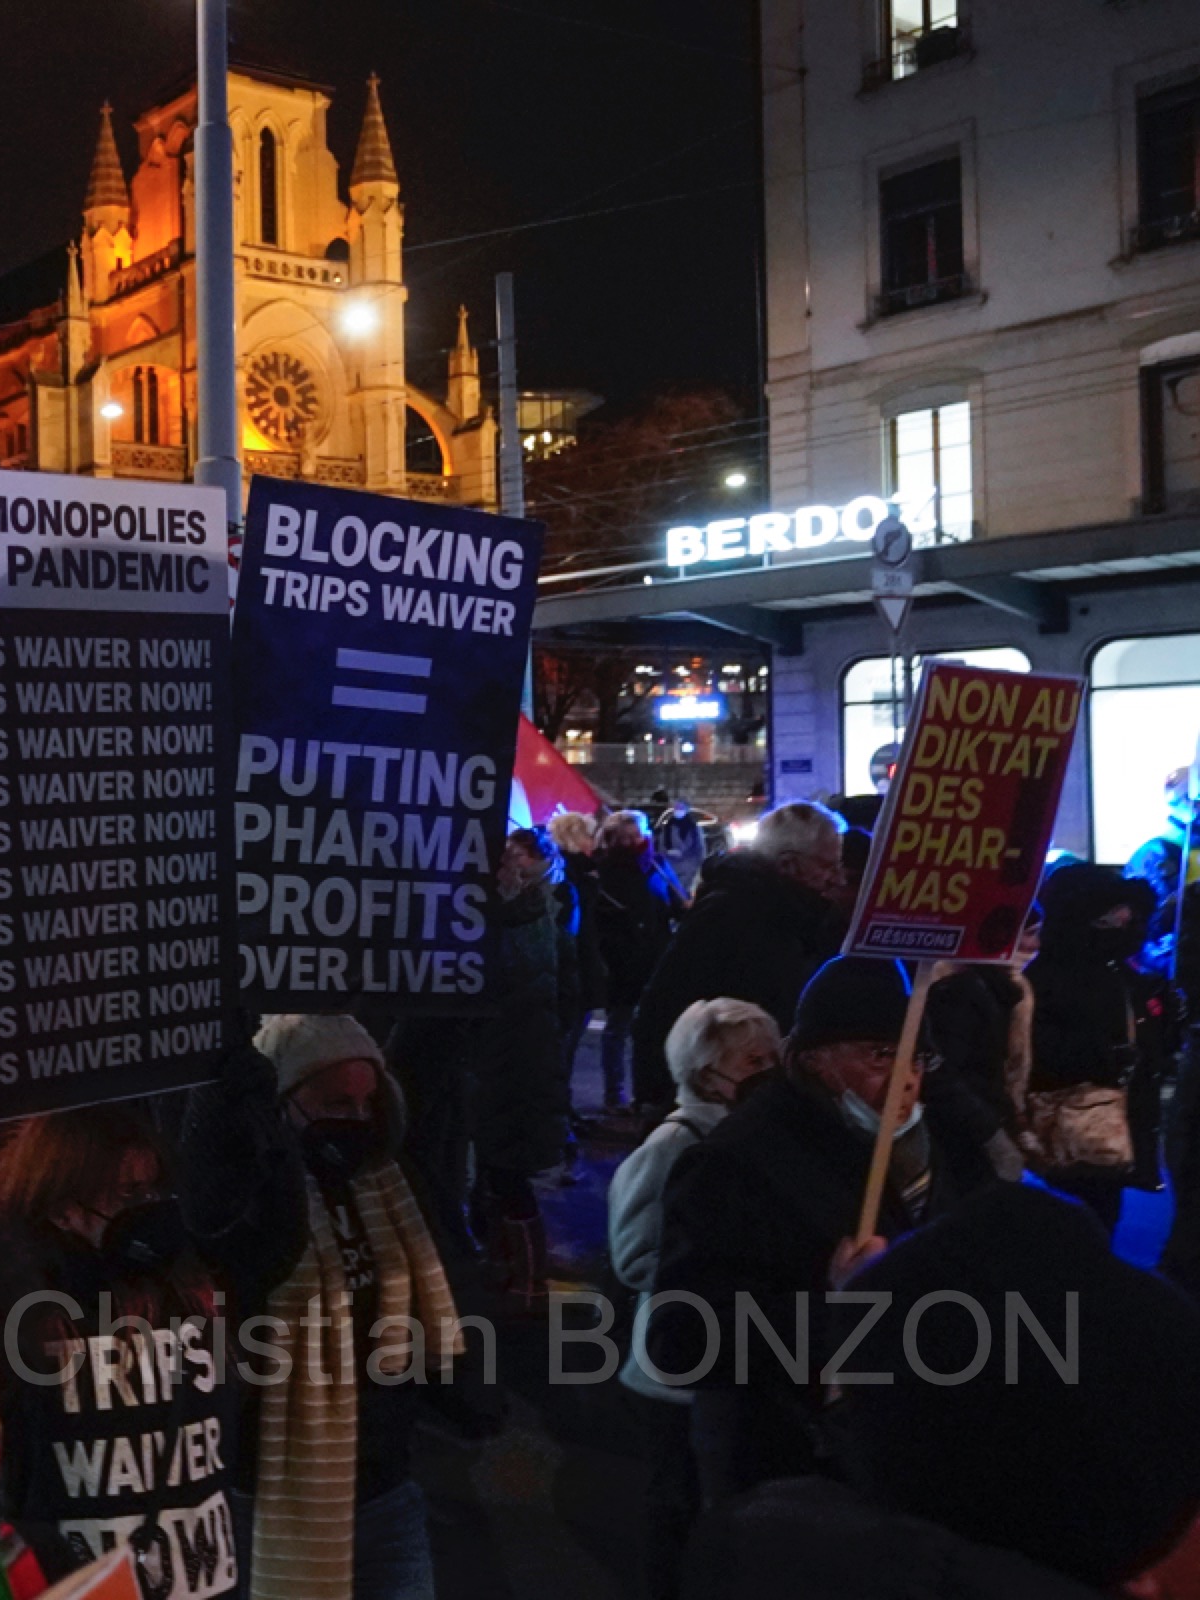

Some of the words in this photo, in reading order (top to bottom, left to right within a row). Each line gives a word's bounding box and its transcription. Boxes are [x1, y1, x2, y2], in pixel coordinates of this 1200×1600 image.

[8, 545, 210, 593] PANDEMIC
[264, 503, 524, 591] BLOCKING
[260, 567, 370, 617] TRIPS
[382, 583, 516, 637] WAIVER
[14, 636, 130, 669] WAIVER
[140, 639, 212, 668] NOW!
[16, 682, 132, 714] WAIVER
[141, 682, 213, 712] NOW!
[925, 675, 1022, 729] NON
[1023, 688, 1080, 734] AU
[17, 727, 133, 760] WAIVER
[142, 724, 214, 753] NOW!
[913, 725, 1059, 779] DIKTAT
[19, 771, 135, 805] WAIVER
[144, 767, 215, 798] NOW!
[236, 733, 496, 811] PUTTING
[901, 773, 984, 821] DES
[20, 814, 136, 850] WAIVER
[144, 810, 216, 842] NOW!
[234, 802, 490, 874] PHARMA
[890, 821, 1021, 869] PHAR-
[21, 858, 137, 896] WAIVER
[145, 852, 217, 885] NOW!
[875, 867, 971, 914] MAS
[23, 902, 138, 943] WAIVER
[147, 894, 218, 929] NOW!
[24, 946, 139, 989] WAIVER
[148, 936, 220, 972] NOW!
[363, 948, 485, 994] LIVES
[26, 990, 141, 1034] WAIVER
[150, 978, 221, 1016] NOW!
[28, 1033, 142, 1080] WAIVER
[151, 1020, 222, 1059] NOW!
[44, 1322, 216, 1413] TRIPS
[52, 1417, 225, 1498] WAIVER
